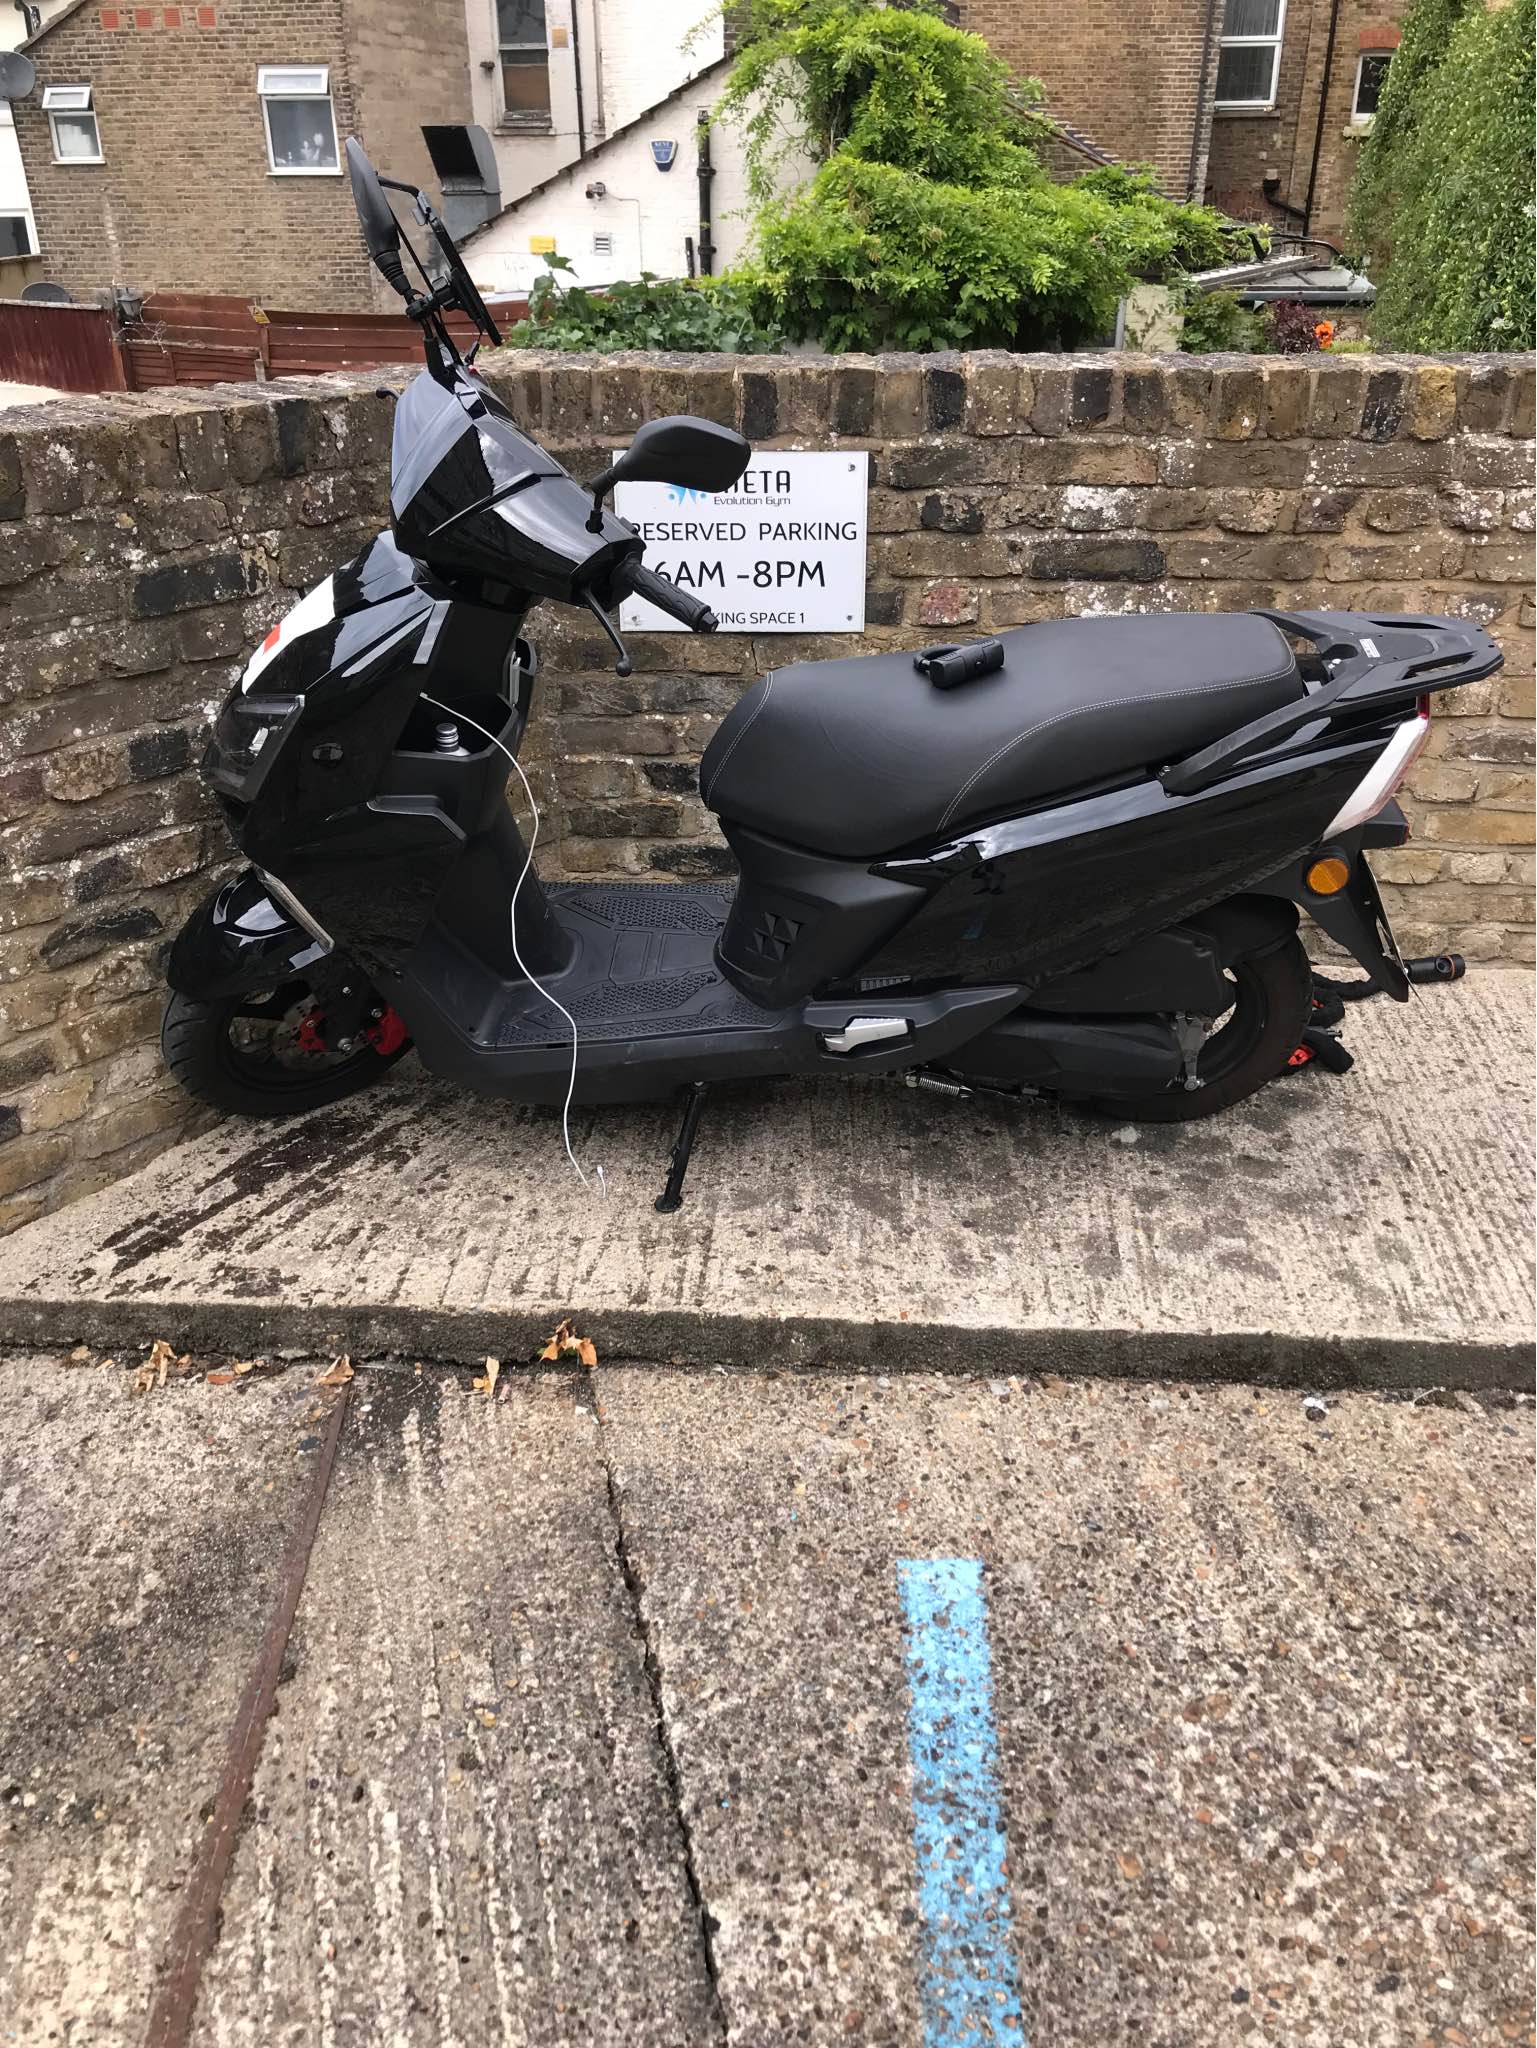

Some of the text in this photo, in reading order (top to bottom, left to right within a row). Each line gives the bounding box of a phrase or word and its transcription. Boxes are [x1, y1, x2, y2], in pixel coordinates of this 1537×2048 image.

[725, 470, 791, 494] ETA
[714, 496, 763, 505] Evolution
[759, 522, 857, 541] PARKING
[749, 612, 796, 624] SPACE
[799, 612, 805, 624] 1
